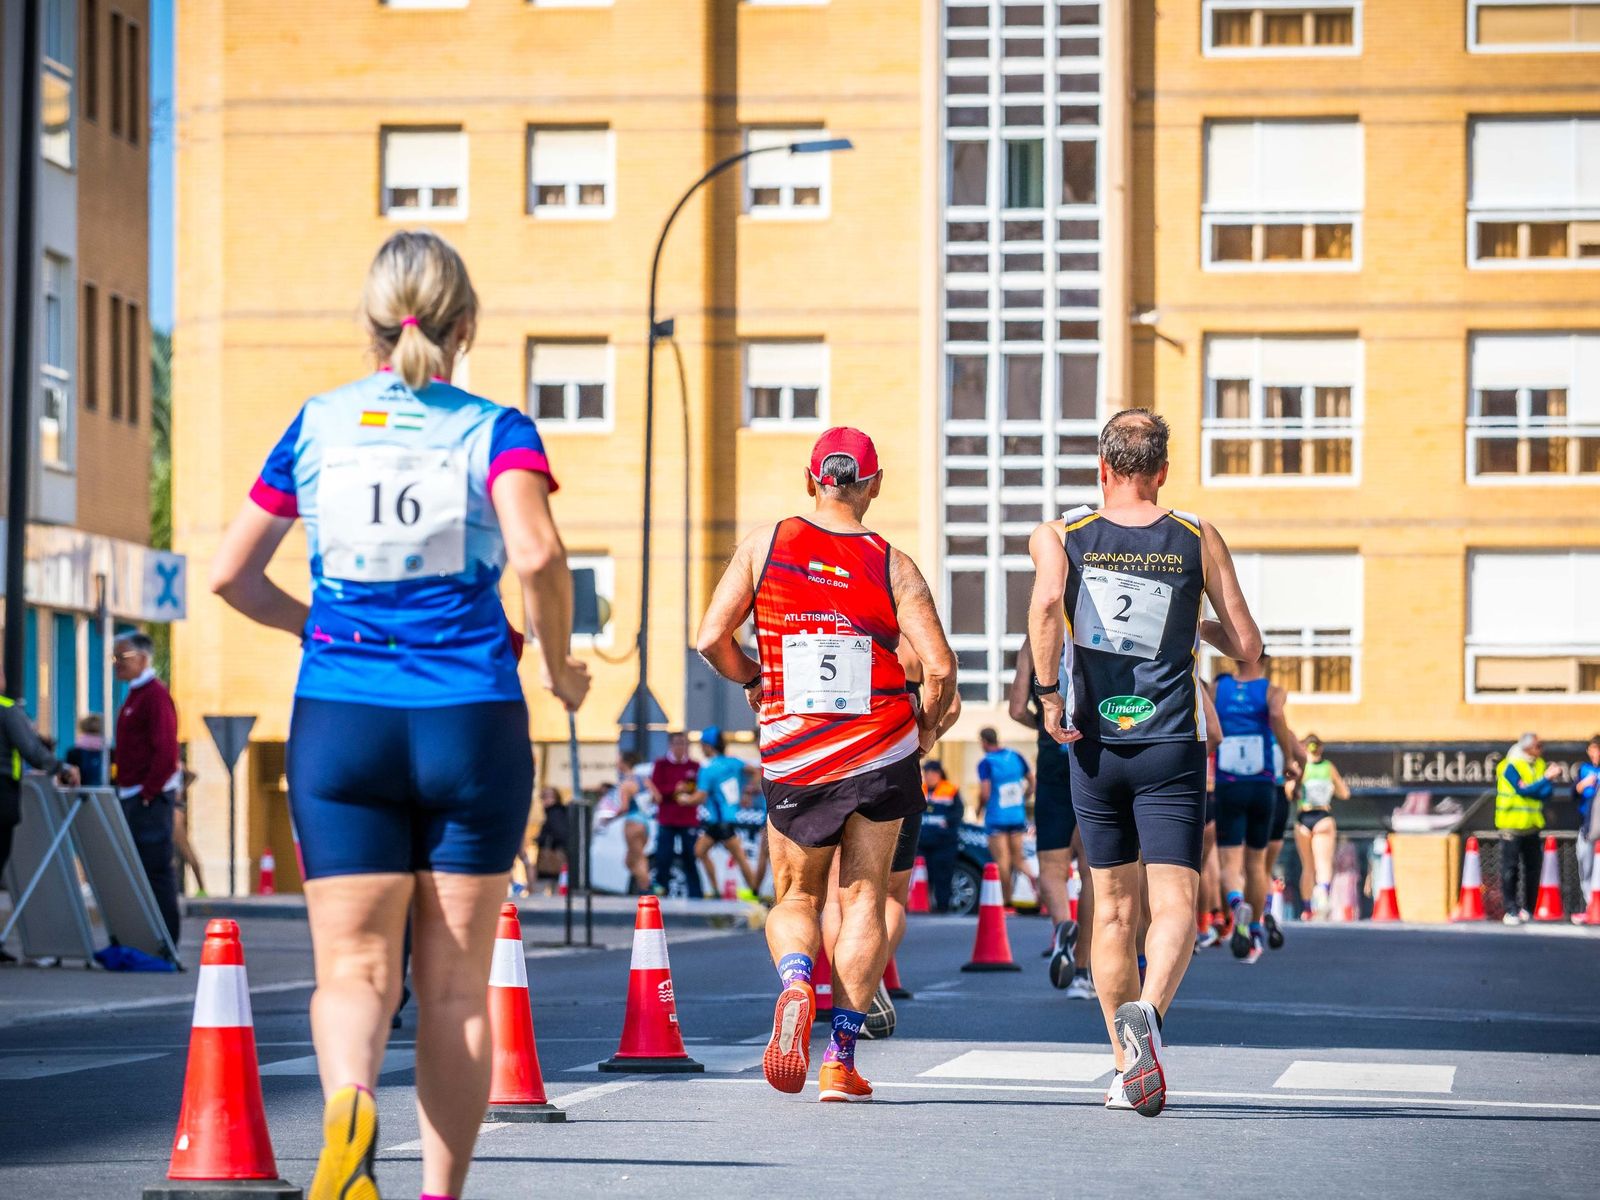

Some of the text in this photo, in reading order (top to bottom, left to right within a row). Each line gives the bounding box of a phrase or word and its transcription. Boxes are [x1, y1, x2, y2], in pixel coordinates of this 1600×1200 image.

[369, 481, 421, 526] 16
[1083, 552, 1183, 565] GRANADA JOVEN
[1122, 565, 1183, 574] ATLETISMO
[807, 575, 849, 589] PACO C.BON
[1112, 594, 1133, 623] 2
[784, 613, 835, 622] ATLETISMO
[819, 654, 837, 681] 5
[1106, 702, 1152, 716] Jiménez
[833, 1014, 860, 1034] Paco
